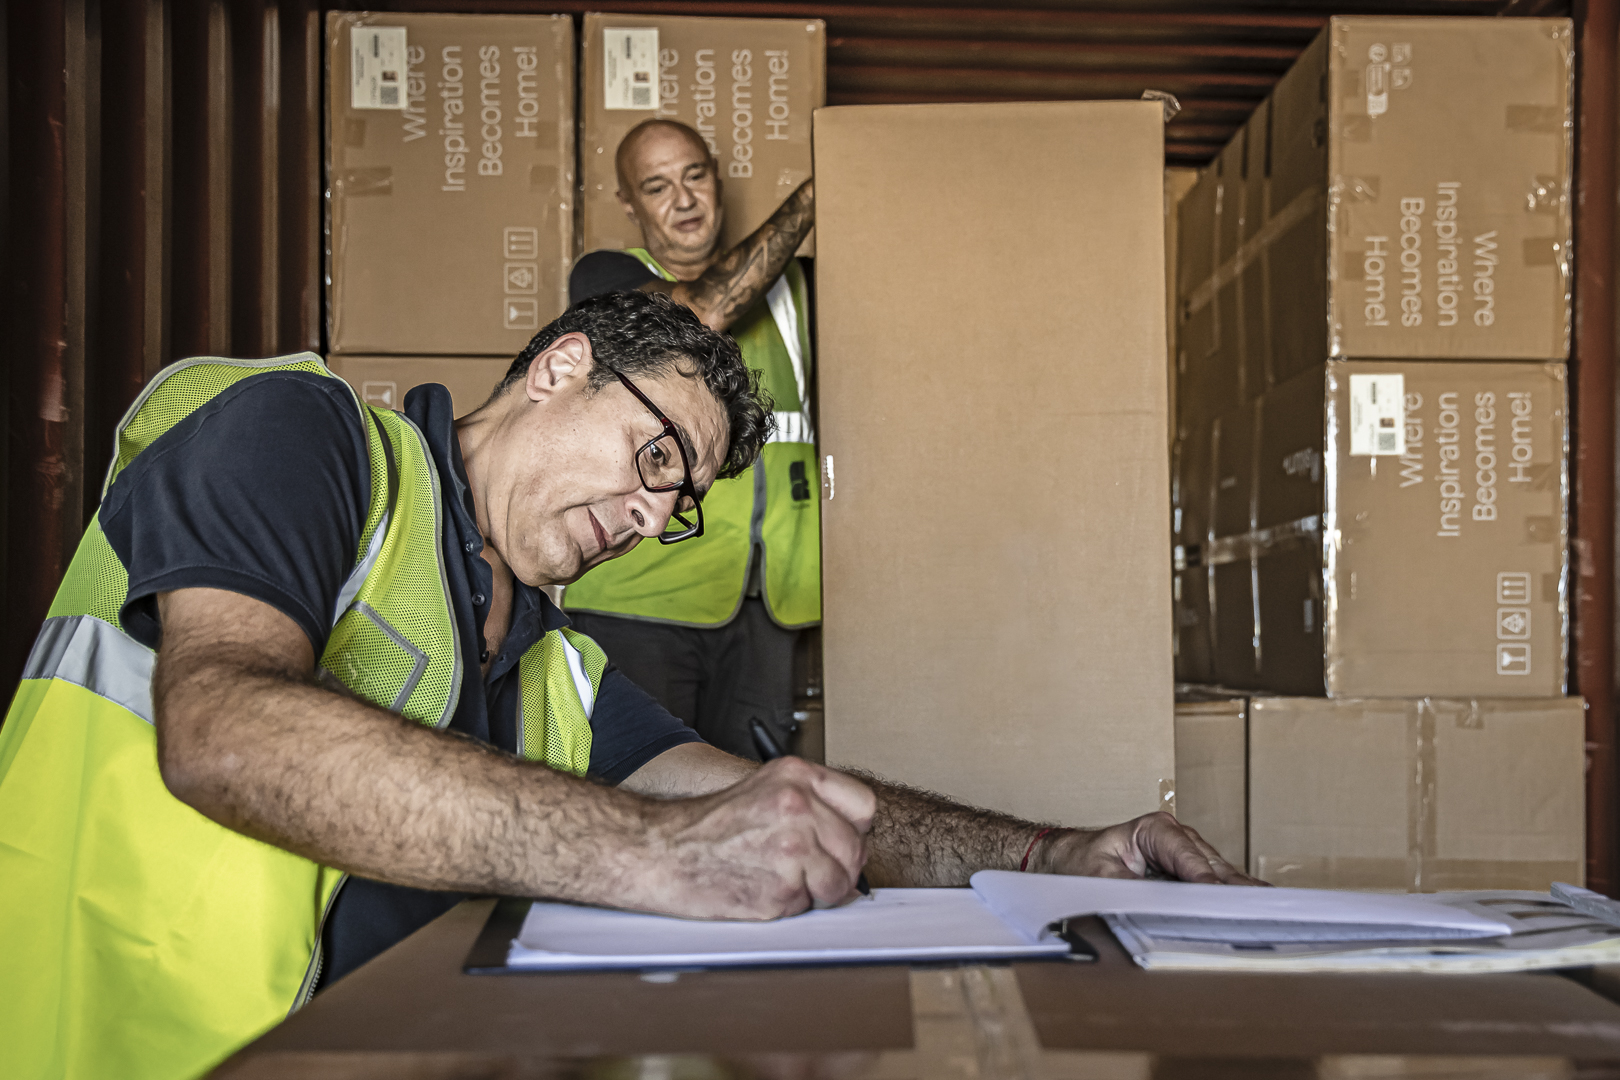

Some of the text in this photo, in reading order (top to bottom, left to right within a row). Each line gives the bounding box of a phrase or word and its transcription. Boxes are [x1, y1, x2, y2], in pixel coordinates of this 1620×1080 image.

[403, 45, 427, 142] Where
[437, 45, 469, 191] Inspiration
[478, 45, 503, 176] Becomes
[512, 46, 539, 137] Home!
[657, 48, 680, 118] here
[689, 48, 721, 155] iration
[728, 48, 753, 178] Becomes
[765, 49, 790, 140] Home!
[1363, 235, 1390, 327] Home!
[1400, 197, 1425, 328] Becomes
[1432, 181, 1464, 327] Inspiration
[1473, 230, 1498, 327] Where
[1400, 391, 1424, 488] Where
[1434, 391, 1466, 537] Inspiration
[1472, 391, 1498, 521] Becomes
[1506, 391, 1533, 483] Home!
